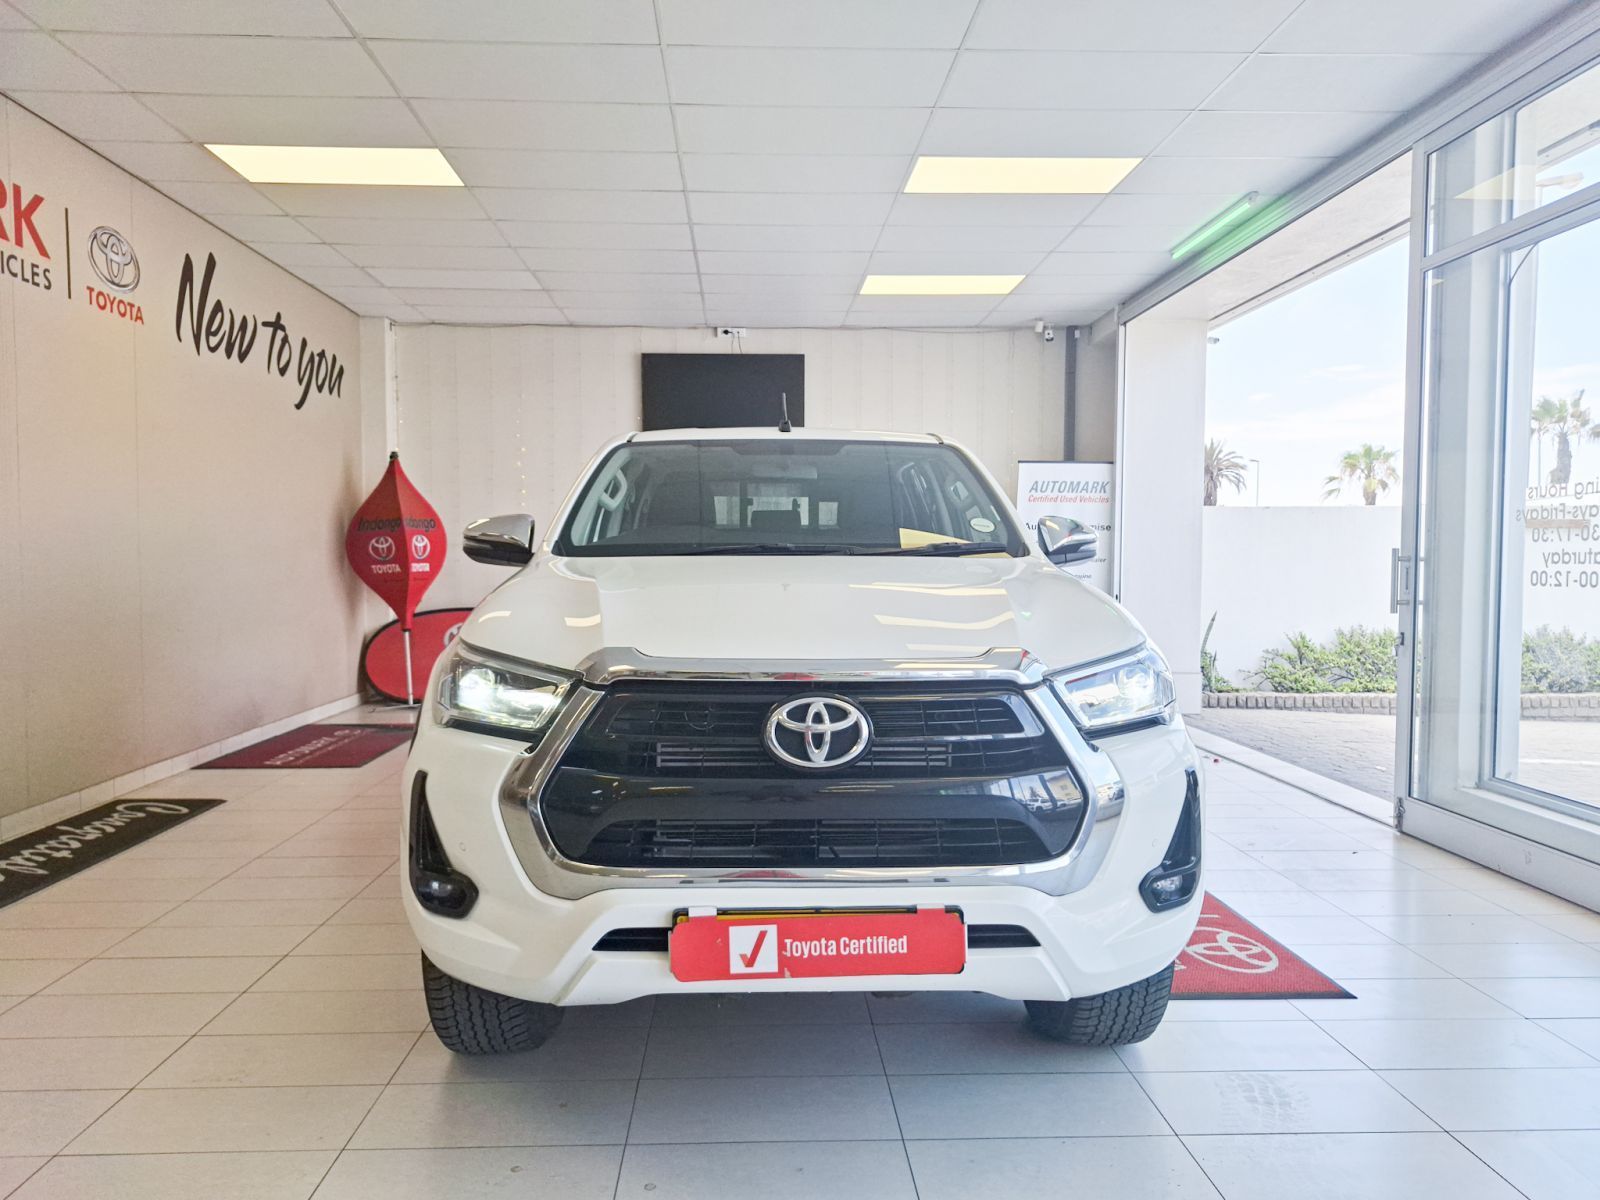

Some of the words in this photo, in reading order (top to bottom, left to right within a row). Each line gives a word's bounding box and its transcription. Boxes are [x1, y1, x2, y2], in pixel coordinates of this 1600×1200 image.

[86, 286, 144, 325] TOYOTA
[175, 252, 257, 364] New
[261, 312, 292, 377] to
[294, 337, 345, 410] you
[1028, 480, 1110, 494] AUTOMARK
[1028, 494, 1058, 503] Certified
[1060, 495, 1077, 503] Used
[1079, 495, 1110, 504] Vehicles
[371, 563, 402, 574] TOYOTA
[783, 937, 835, 958] Toyota
[839, 935, 908, 955] Certified
